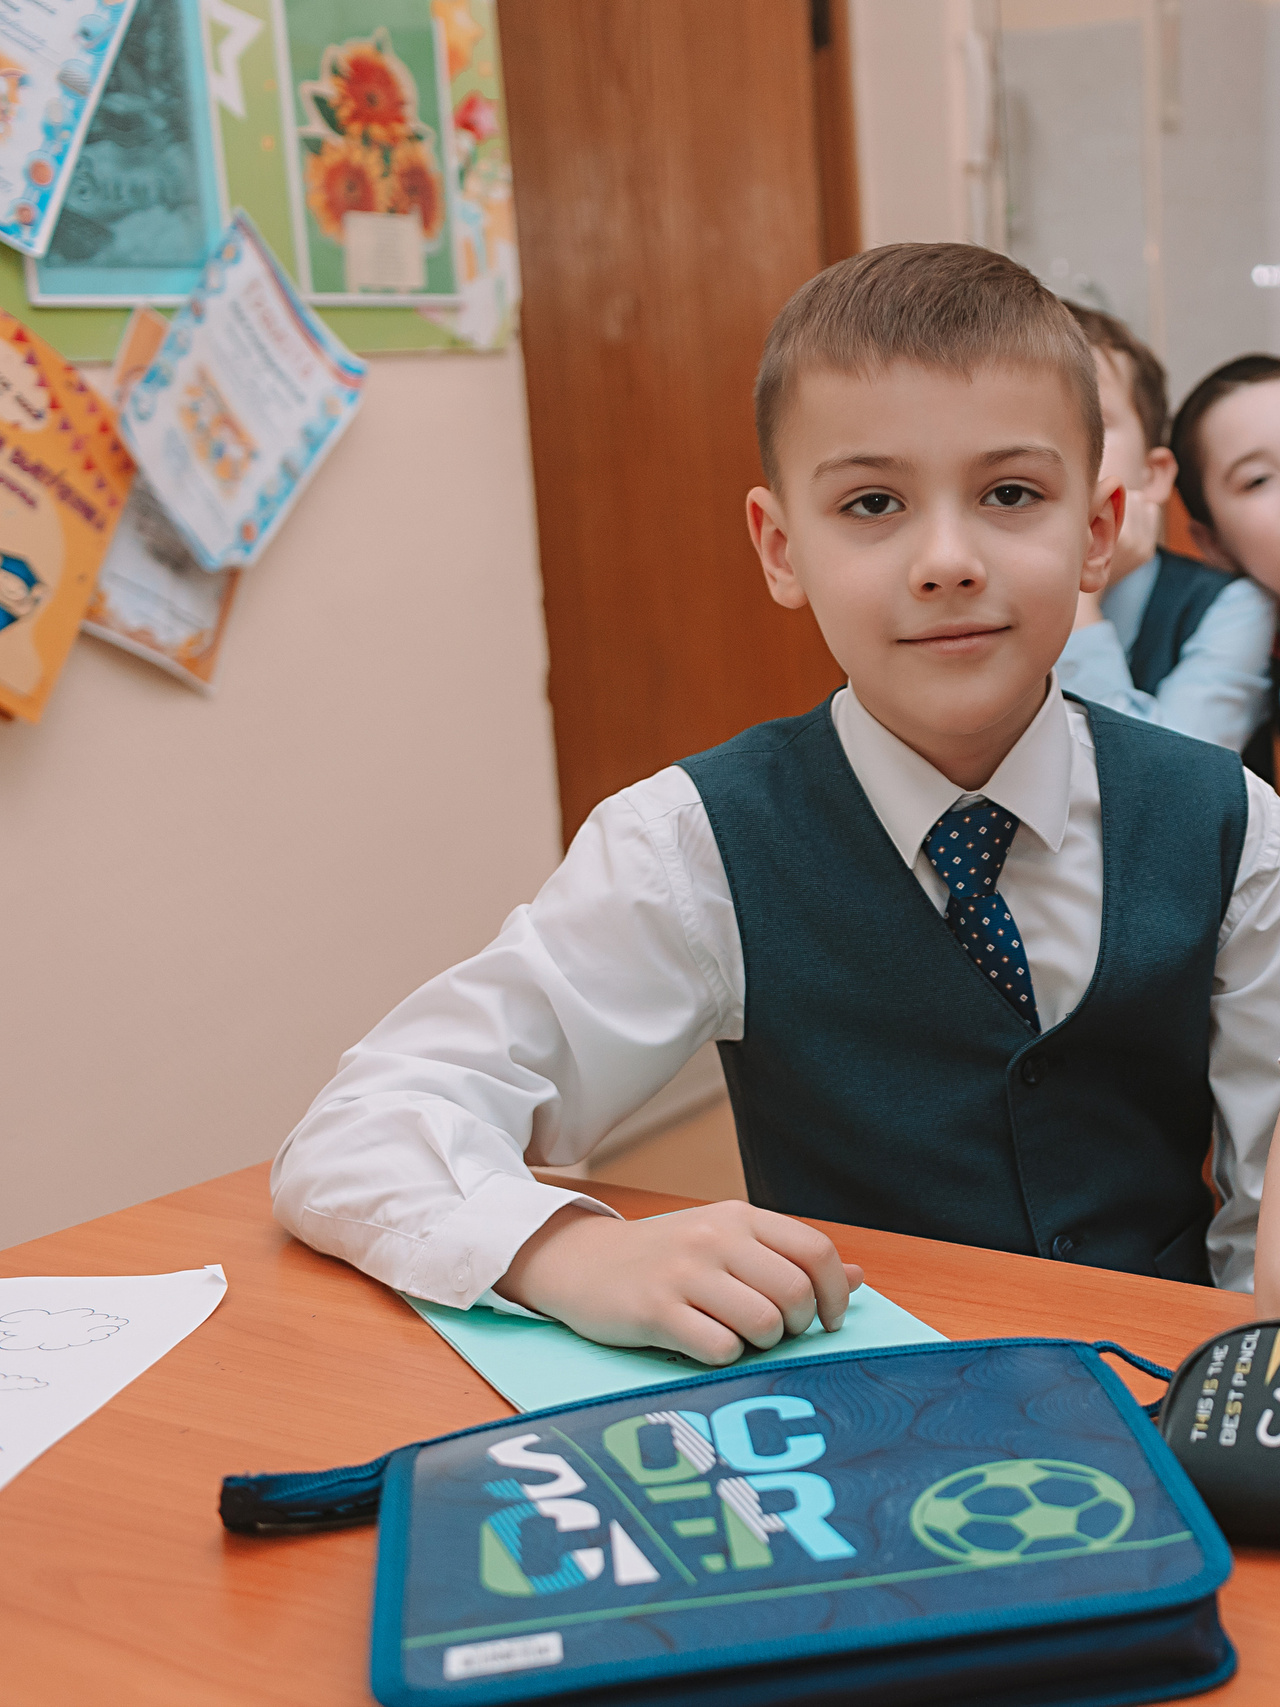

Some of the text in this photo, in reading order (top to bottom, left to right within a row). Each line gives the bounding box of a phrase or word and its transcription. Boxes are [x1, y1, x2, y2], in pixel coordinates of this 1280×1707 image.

[1190, 1344, 1229, 1443] THIS IS THE
[1219, 1329, 1261, 1447] BEST PENCIL
